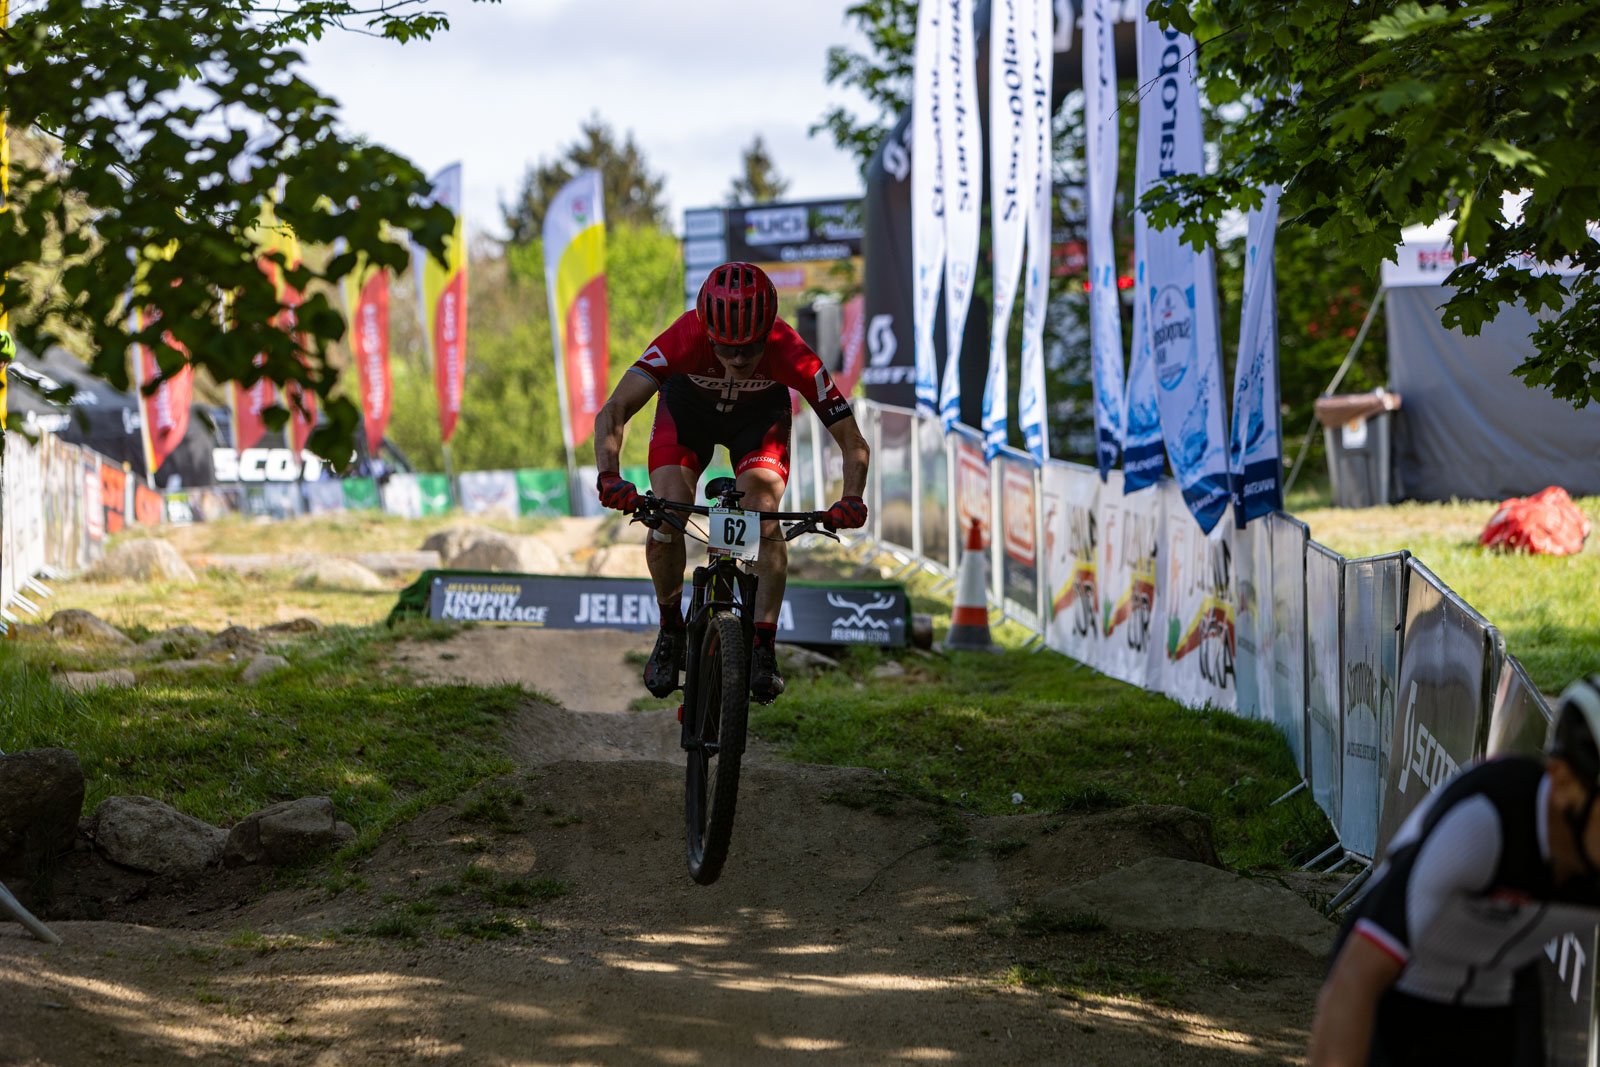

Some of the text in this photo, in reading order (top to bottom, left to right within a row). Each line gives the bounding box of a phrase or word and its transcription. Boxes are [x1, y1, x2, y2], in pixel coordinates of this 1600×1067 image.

[724, 517, 747, 546] 62
[444, 591, 521, 608] TROPHY
[497, 606, 548, 622] RACE
